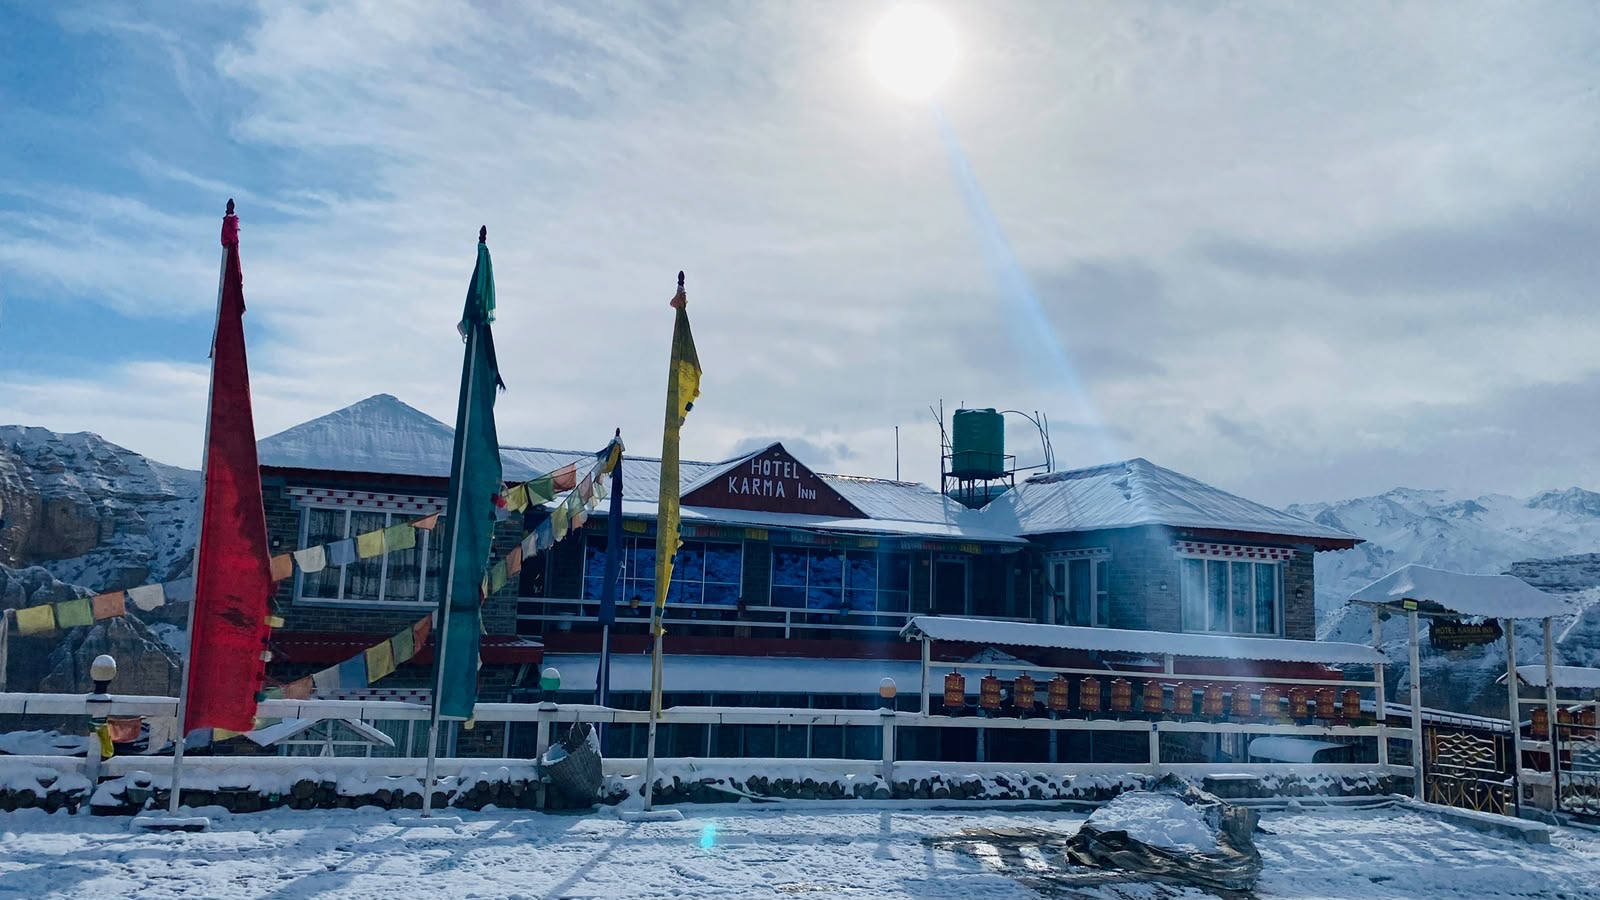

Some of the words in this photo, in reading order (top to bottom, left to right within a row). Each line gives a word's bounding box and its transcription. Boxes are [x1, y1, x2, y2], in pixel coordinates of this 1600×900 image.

[751, 459, 800, 479] HOTEL
[728, 476, 785, 498] KARMA
[1435, 626, 1456, 635] HOTEL
